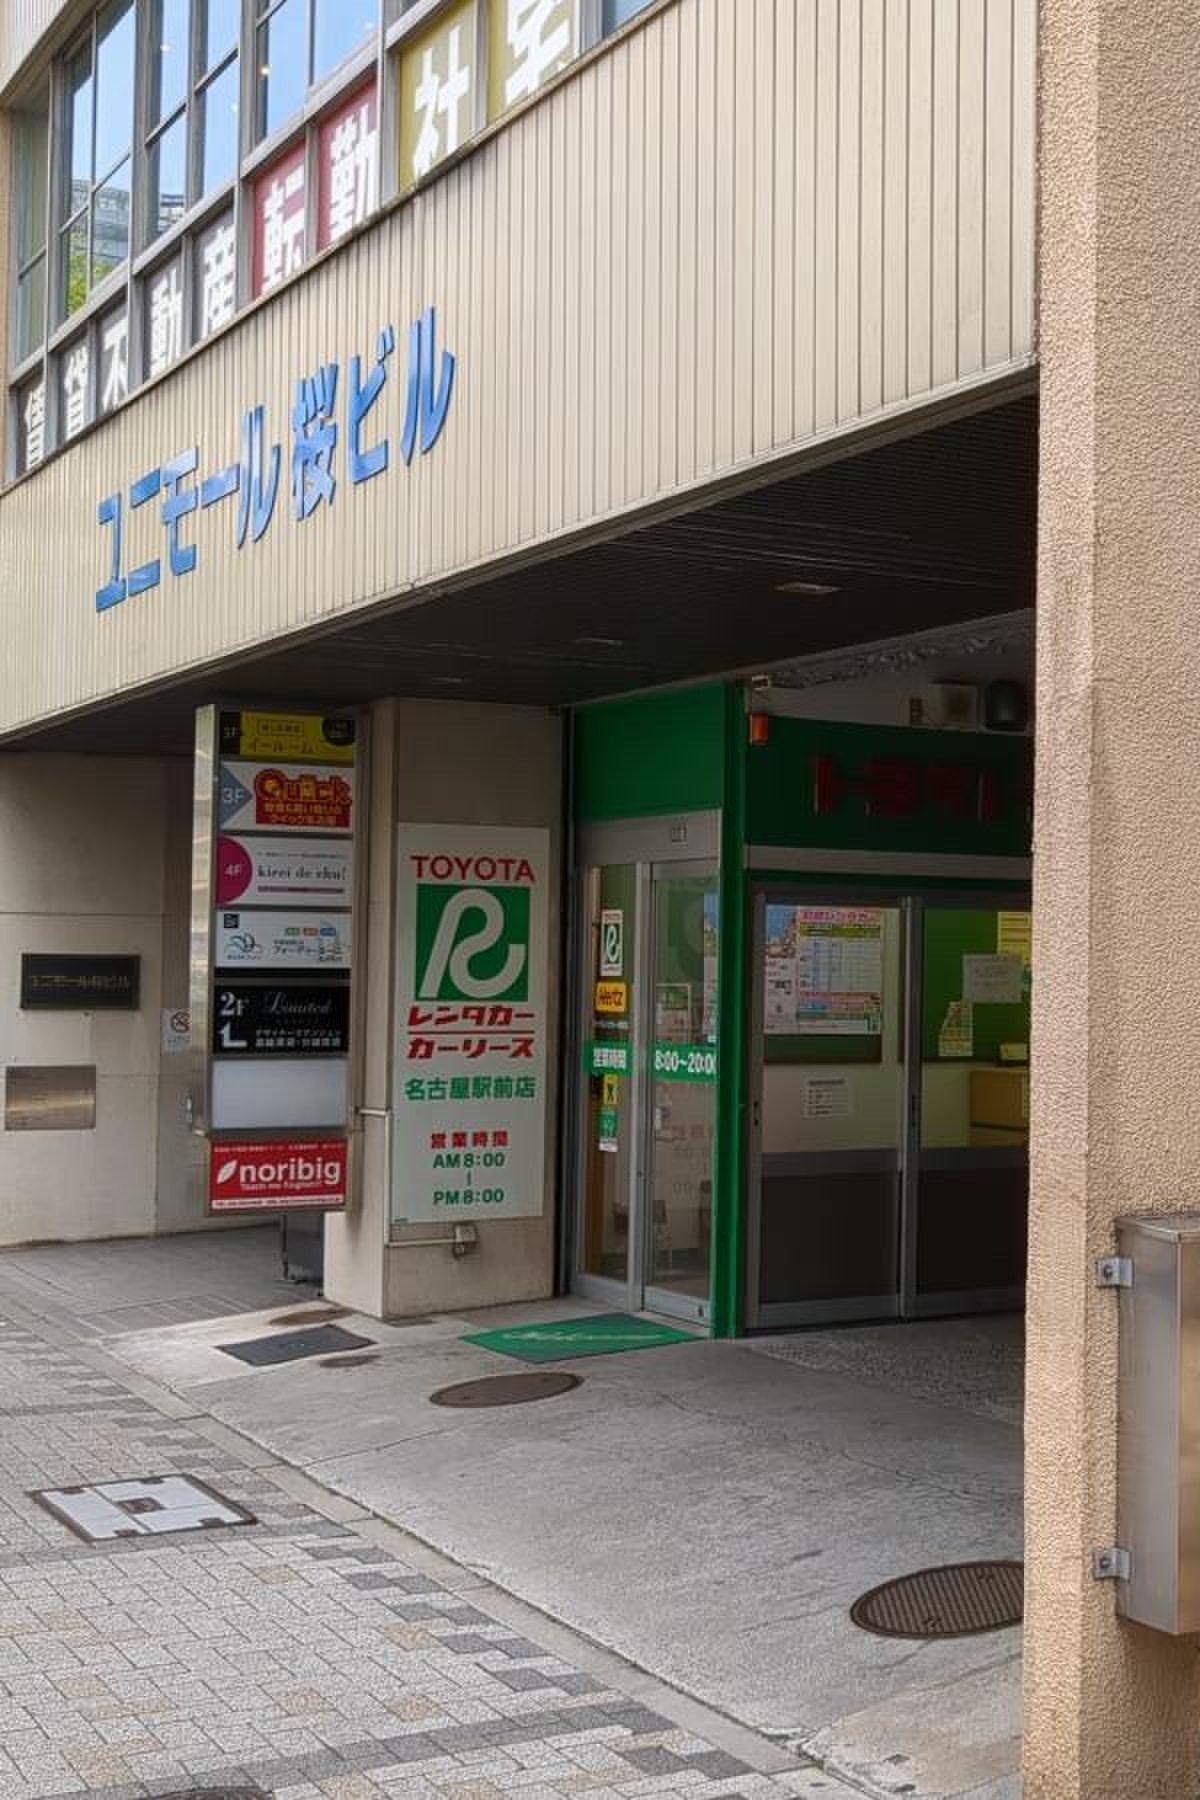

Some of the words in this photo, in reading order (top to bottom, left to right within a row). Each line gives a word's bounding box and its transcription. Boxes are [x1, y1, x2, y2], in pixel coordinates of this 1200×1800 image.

[96, 306, 456, 613] ユニモール桜ビル
[410, 855, 535, 882] TOYOTA
[408, 1005, 535, 1026] レンタカー
[408, 1038, 535, 1059] カーリース
[405, 1075, 536, 1101] 名古屋駅前店
[431, 1130, 508, 1149] 営業時間
[239, 1156, 341, 1185] noribig
